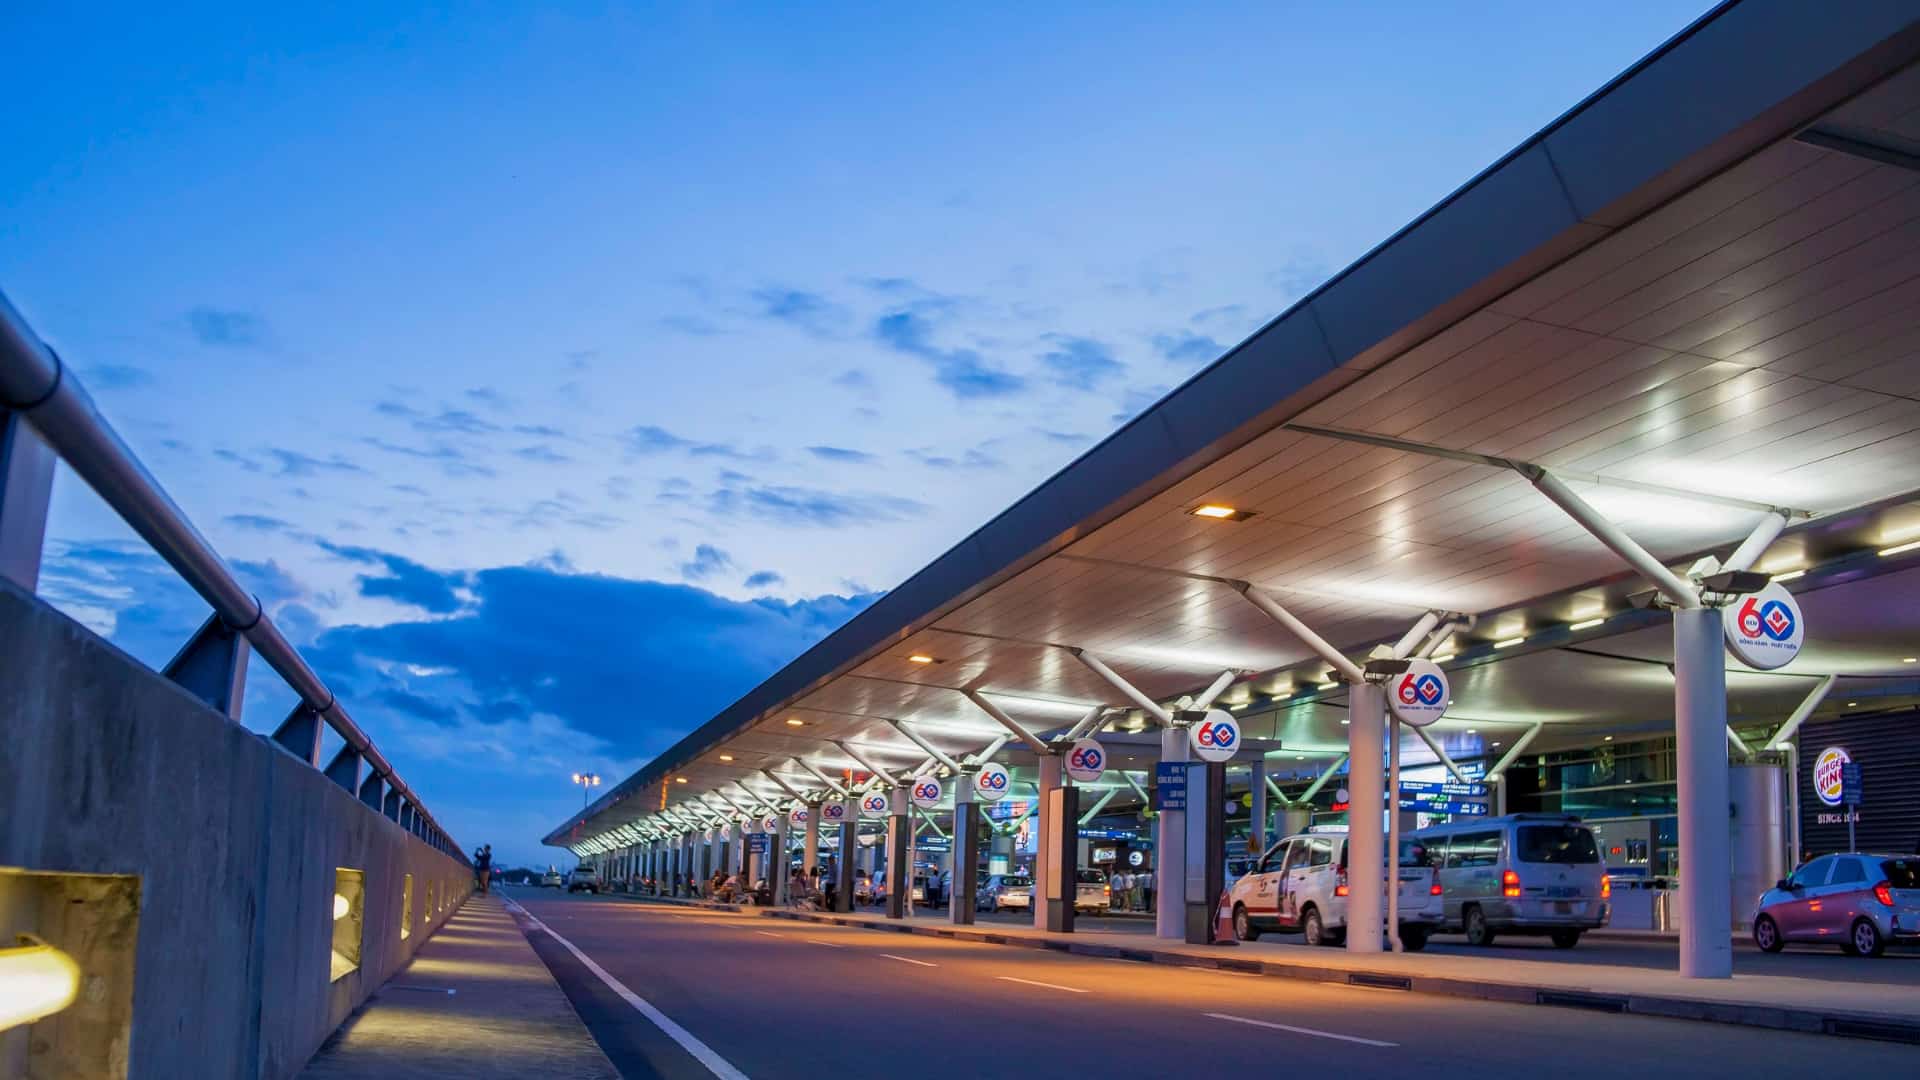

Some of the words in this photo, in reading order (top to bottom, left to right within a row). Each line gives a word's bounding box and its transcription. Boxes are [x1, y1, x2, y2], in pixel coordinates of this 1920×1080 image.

[1738, 597, 1795, 641] 60
[1398, 673, 1443, 706] 60
[1198, 722, 1236, 747] 60
